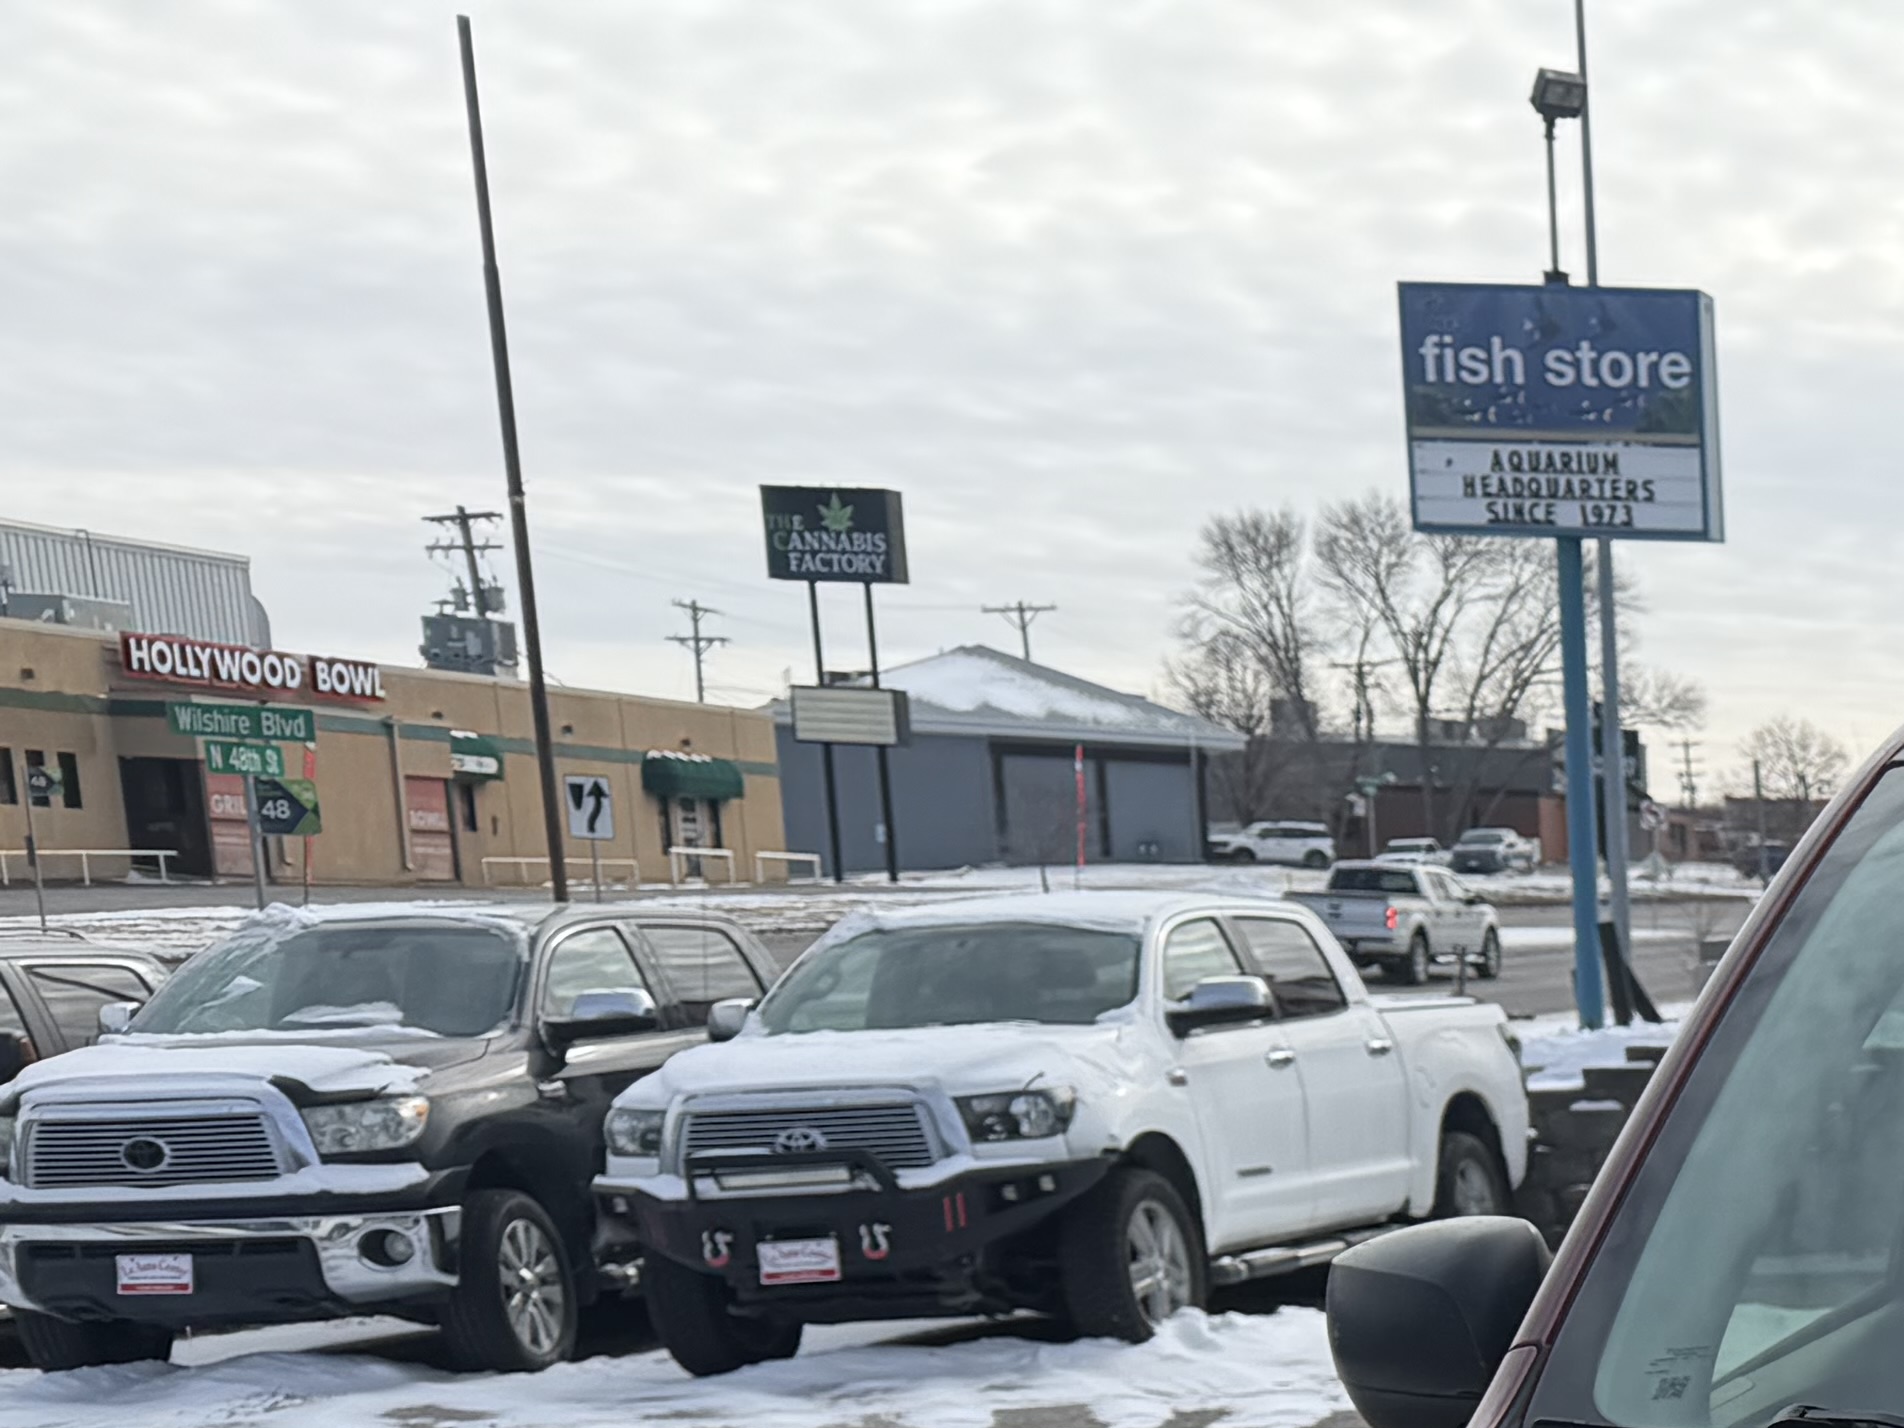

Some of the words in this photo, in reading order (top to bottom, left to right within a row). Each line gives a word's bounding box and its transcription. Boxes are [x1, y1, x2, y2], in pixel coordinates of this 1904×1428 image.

[1418, 335, 1525, 385] fish
[1544, 340, 1693, 388] store
[1489, 449, 1620, 476] AQUARIUM
[1461, 474, 1656, 503] HEADQUARTERS
[1485, 501, 1557, 526] SINCE
[1579, 503, 1635, 528] 1973
[772, 530, 888, 553] CANNABIS
[787, 551, 887, 575] FACTORY
[128, 637, 301, 690] HOLLYWOOD
[315, 660, 387, 698] BOWL
[174, 706, 250, 735] Wilshire
[260, 711, 307, 738] Blvd
[209, 743, 224, 769] N
[228, 744, 262, 772] 48th
[264, 748, 280, 775] St
[260, 799, 291, 820] 48
